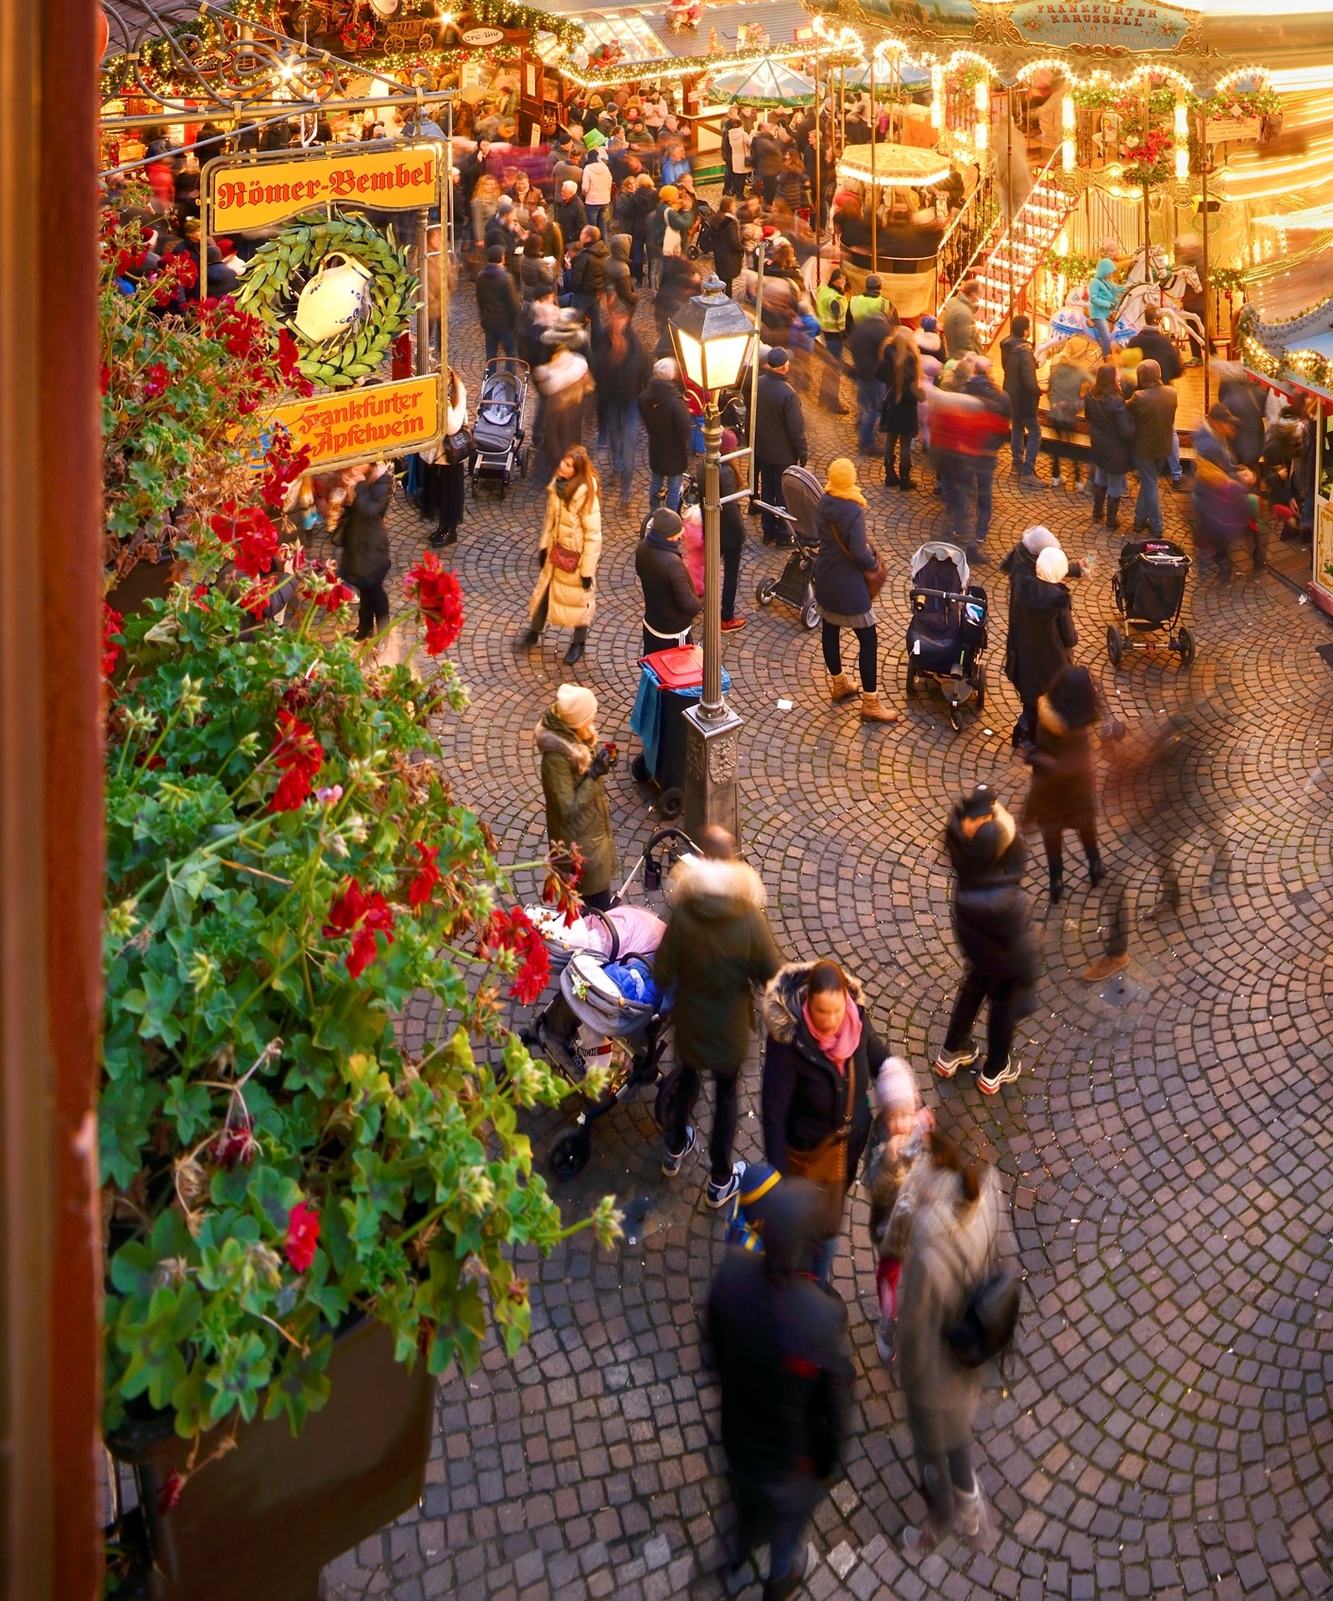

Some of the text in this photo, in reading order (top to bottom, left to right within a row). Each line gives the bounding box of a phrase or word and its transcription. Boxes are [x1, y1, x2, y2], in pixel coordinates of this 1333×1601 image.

[1037, 4, 1158, 19] FRANKFURTER
[1051, 14, 1143, 27] KARUSSELL
[218, 160, 434, 210] Römer-Bembel
[300, 392, 423, 434] Frankfurter
